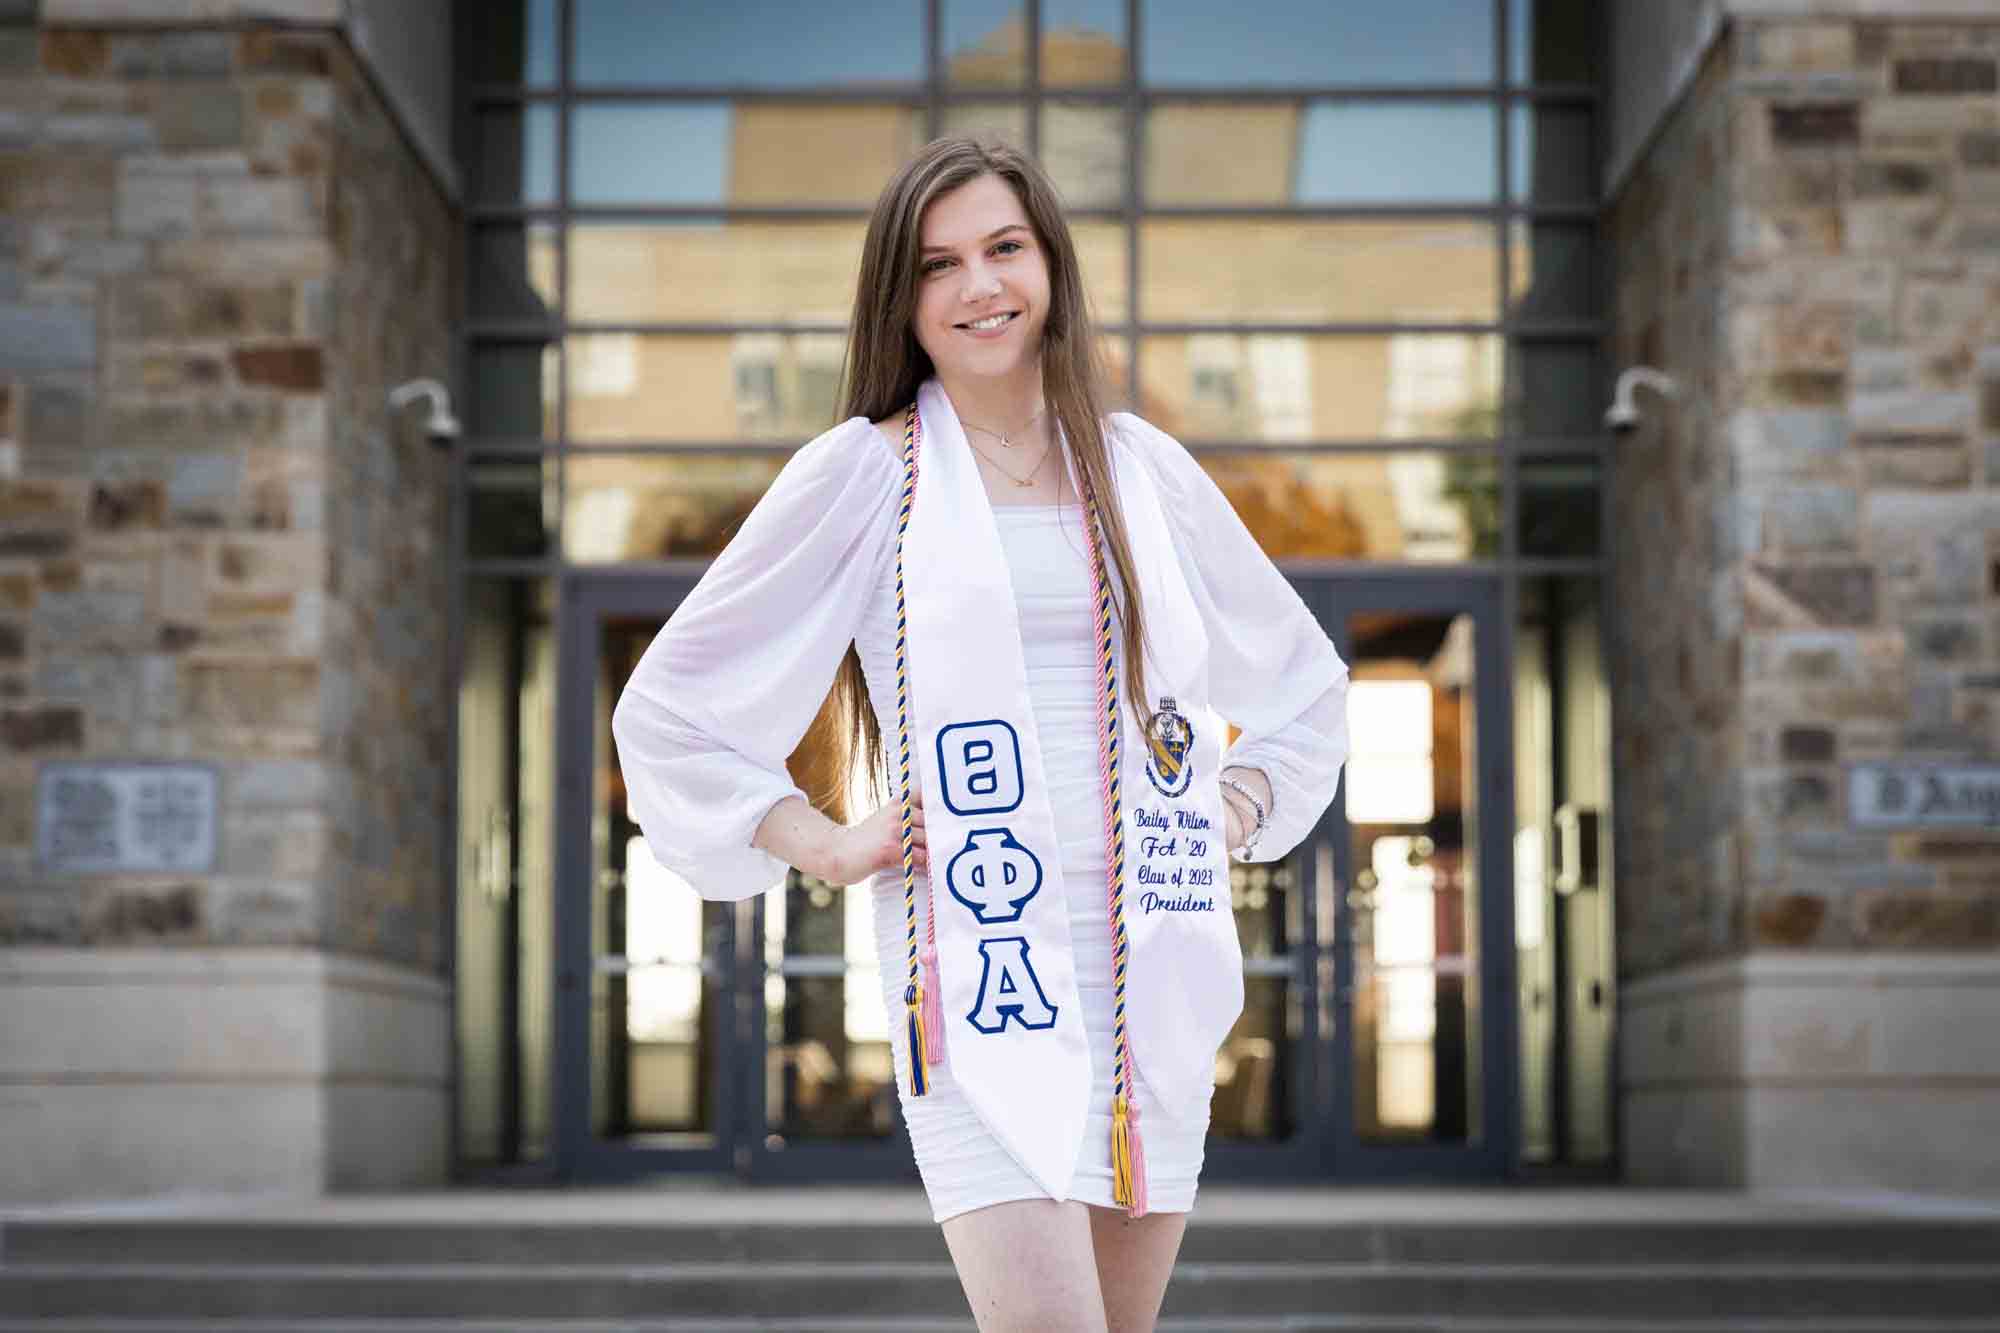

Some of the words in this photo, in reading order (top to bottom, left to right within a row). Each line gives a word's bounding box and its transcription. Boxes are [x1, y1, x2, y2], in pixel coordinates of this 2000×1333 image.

[1134, 807, 1170, 832] Bailey
[1174, 810, 1211, 830] Wilson
[1140, 836, 1177, 858] FA
[1185, 836, 1207, 857] '20
[1137, 864, 1167, 885] Class
[1171, 867, 1183, 888] of
[1188, 868, 1213, 886] 2023
[1140, 891, 1215, 915] President
